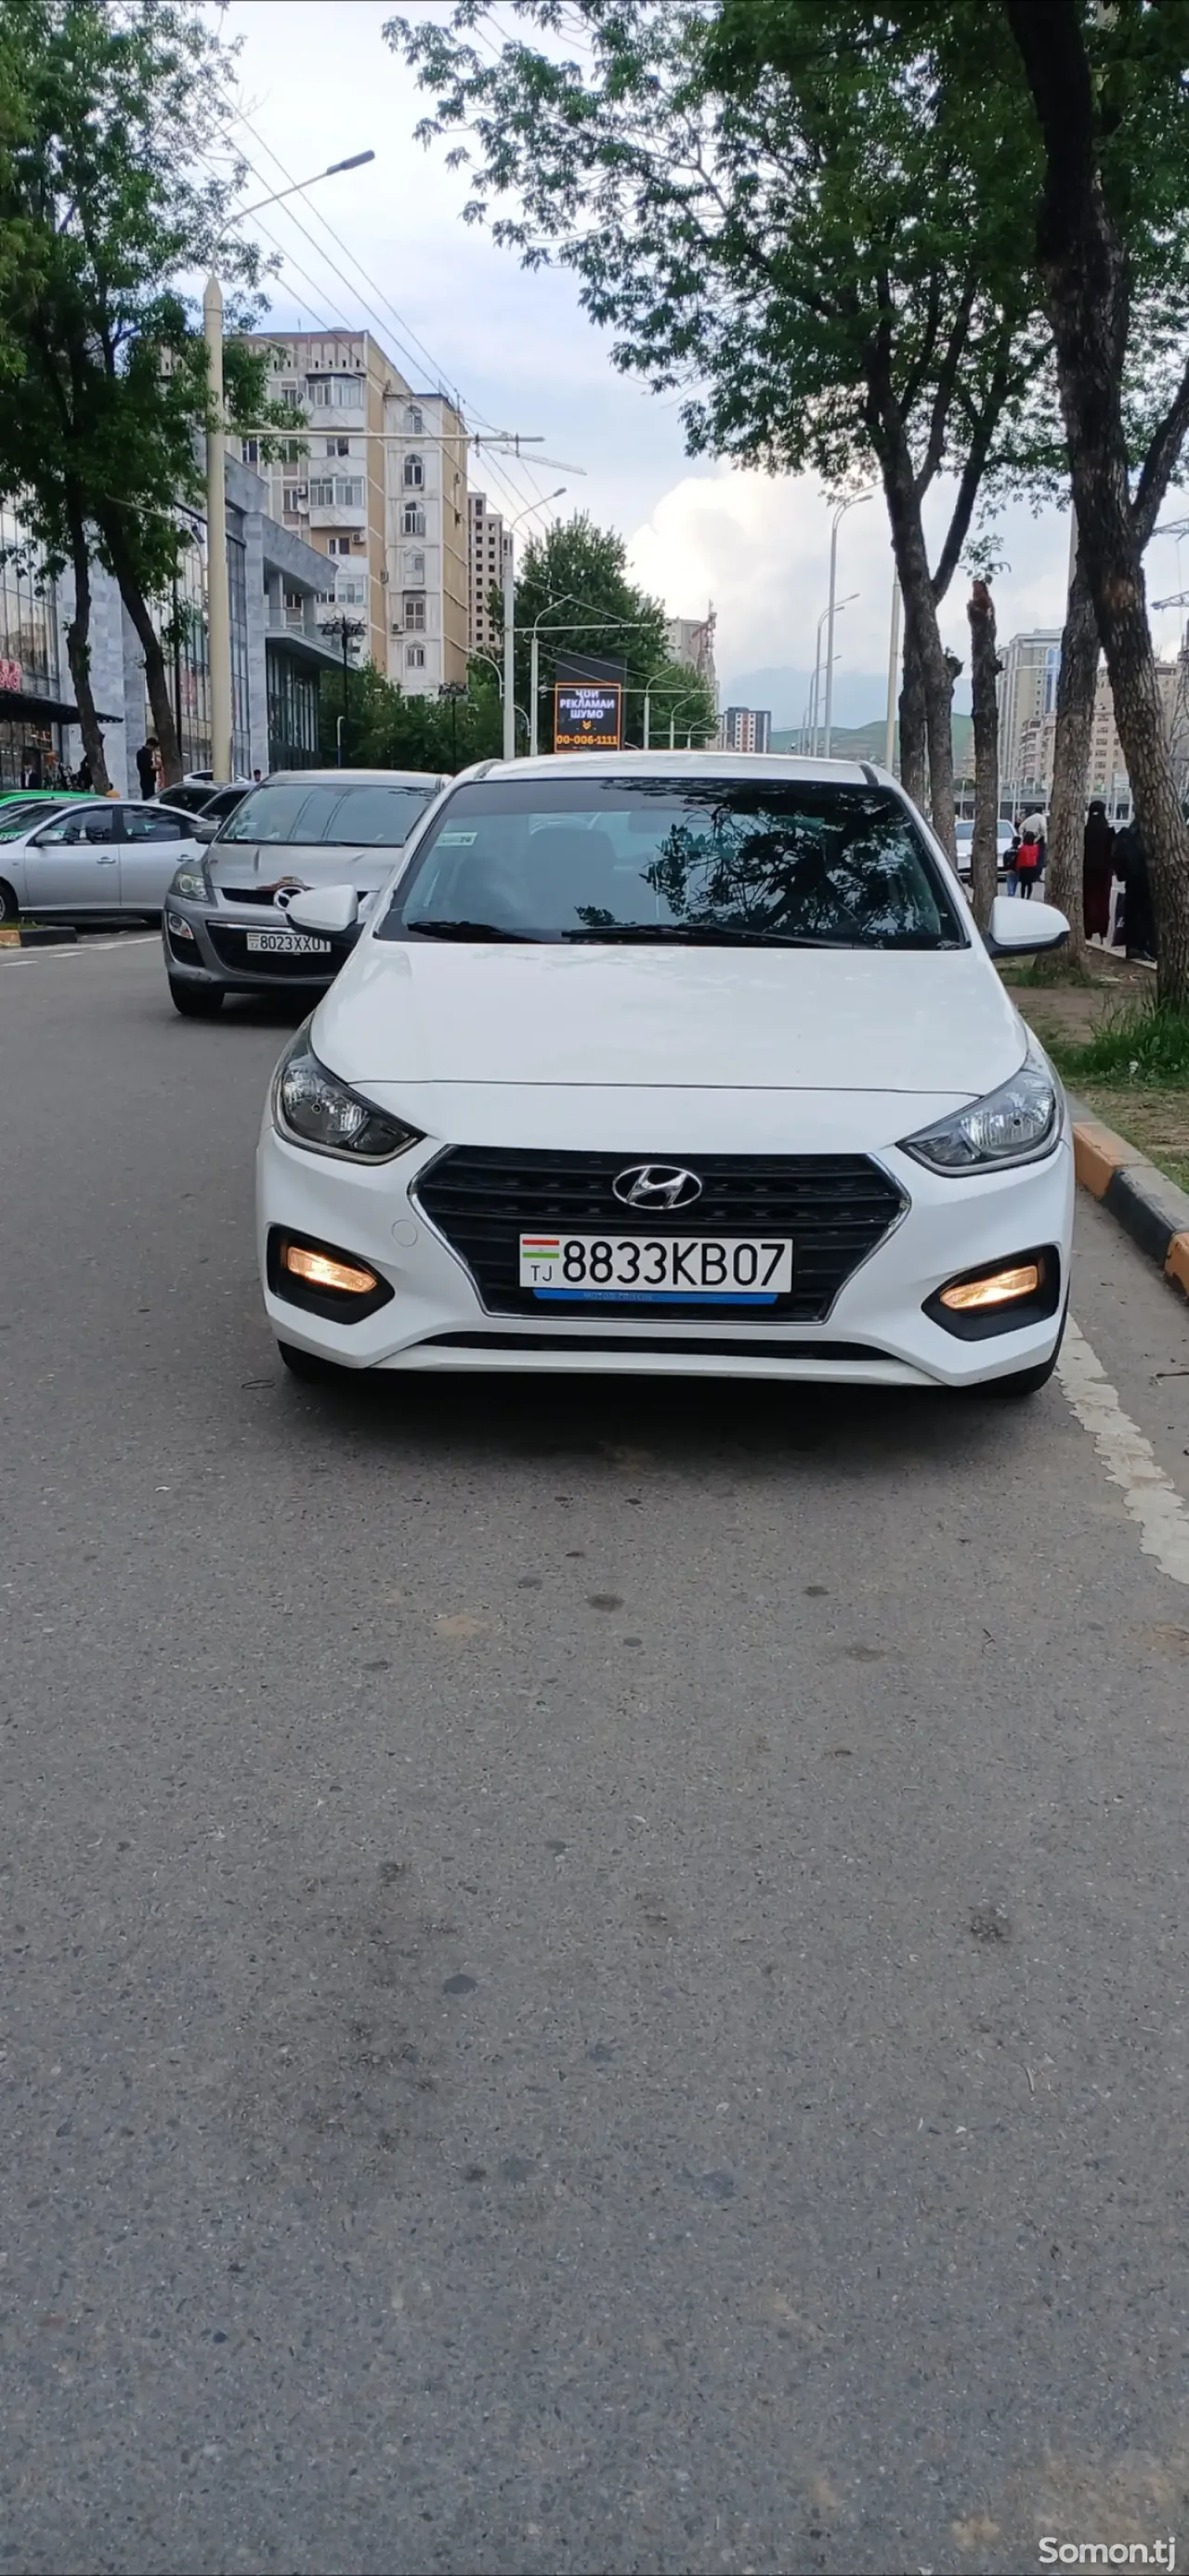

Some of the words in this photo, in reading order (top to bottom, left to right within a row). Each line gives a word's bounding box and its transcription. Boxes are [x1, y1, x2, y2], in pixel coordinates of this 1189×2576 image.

[569, 709, 604, 719] ШУМО
[530, 1265, 553, 1281] TJ
[562, 1240, 786, 1287] 8833KB07
